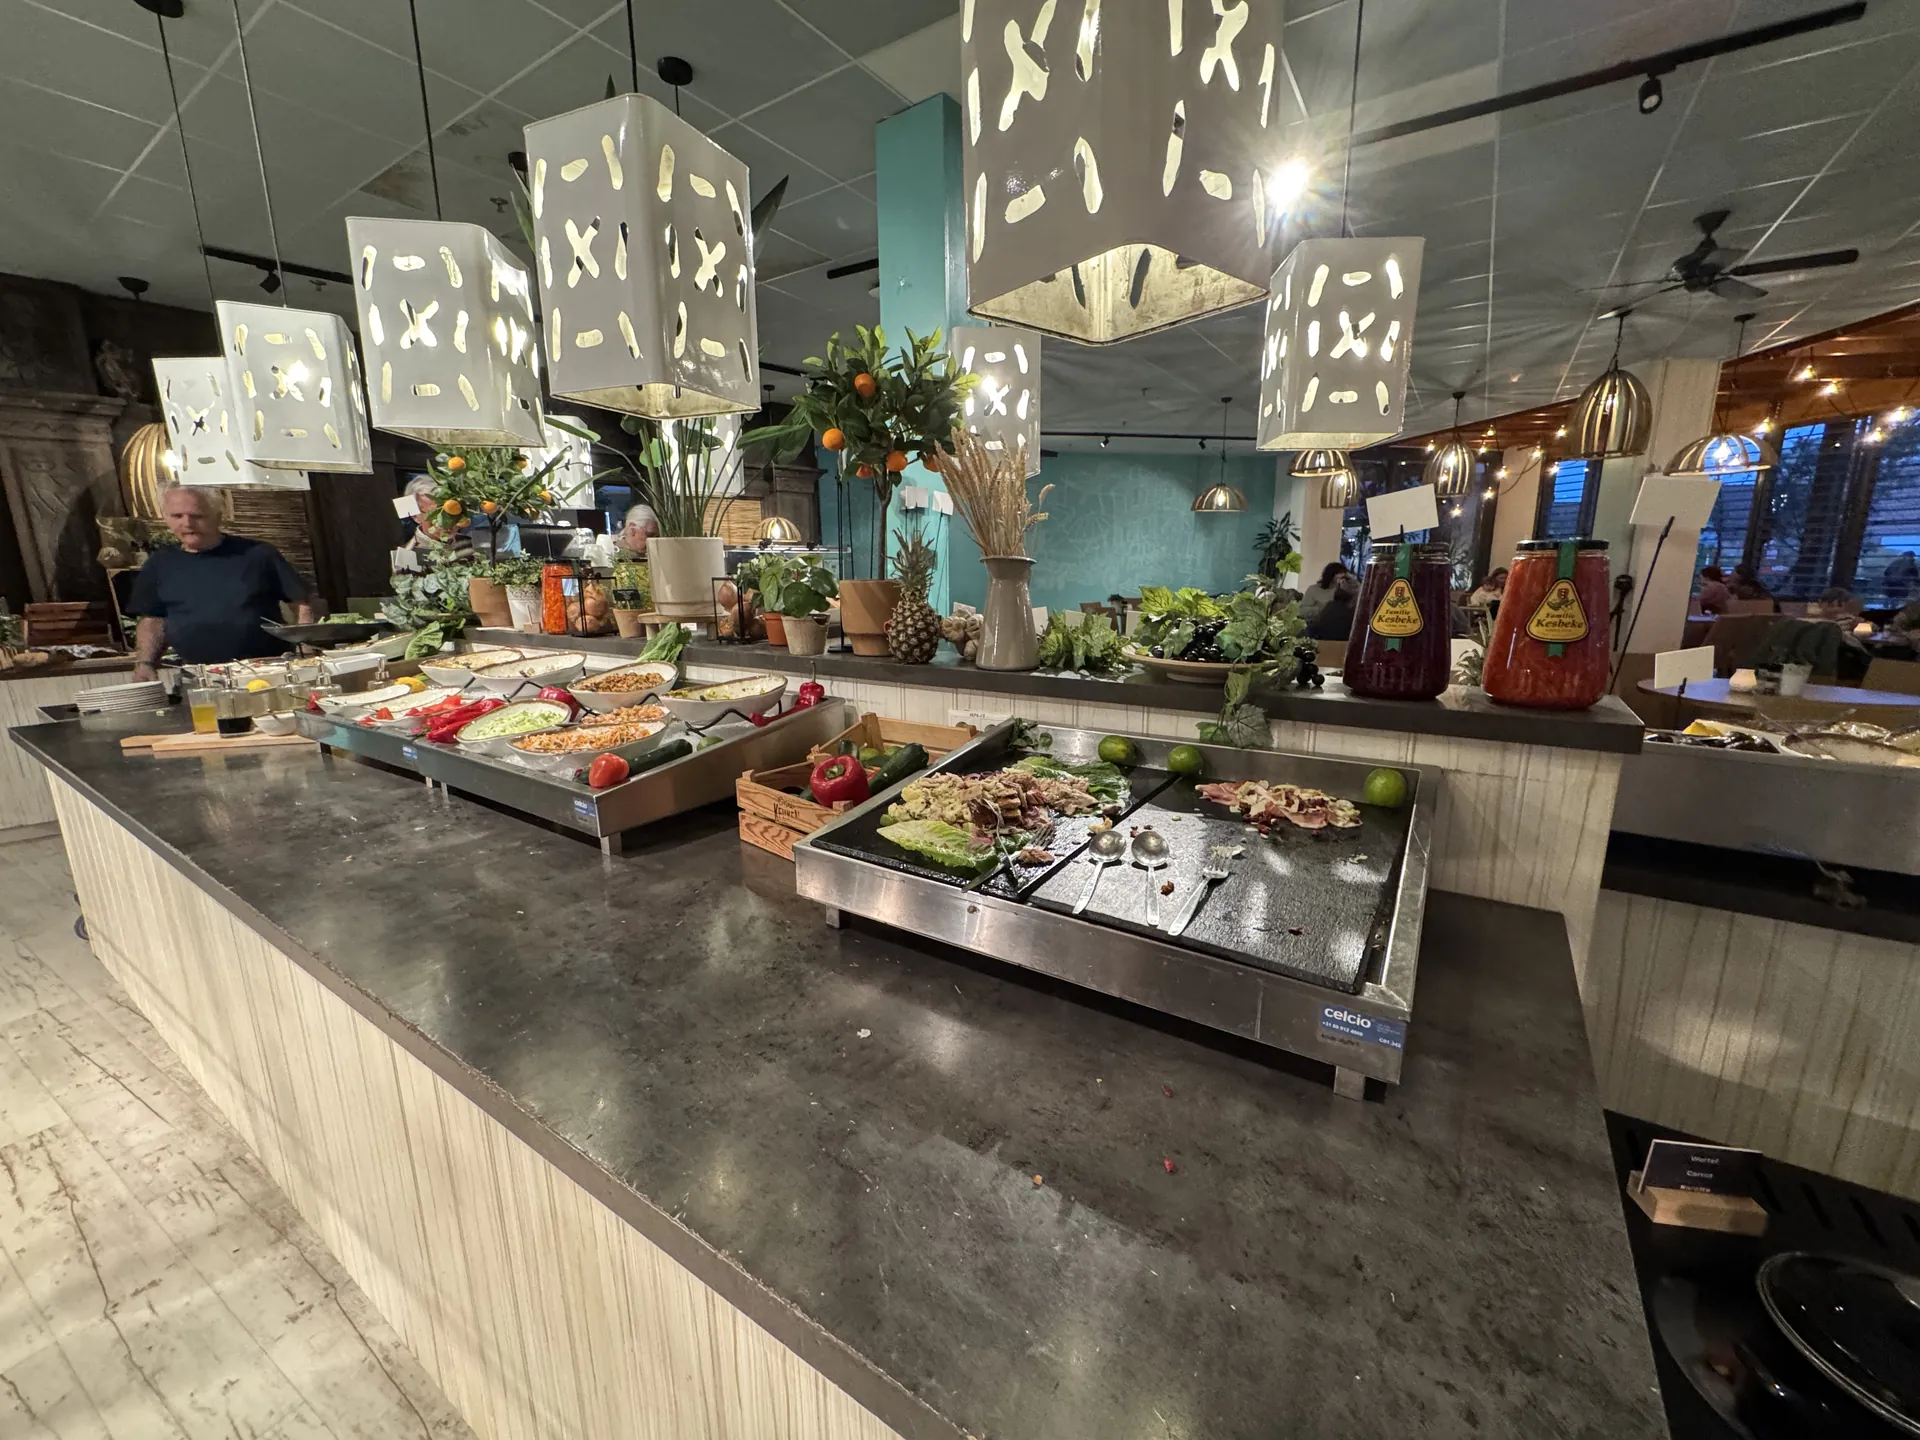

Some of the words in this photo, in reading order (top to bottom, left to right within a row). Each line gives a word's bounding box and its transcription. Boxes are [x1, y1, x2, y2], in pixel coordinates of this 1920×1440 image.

[1377, 614, 1418, 624] Kesbeke
[1535, 618, 1584, 629] Kesbeke
[1324, 1008, 1371, 1028] celcio
[1686, 1170, 1713, 1178] Carrot
